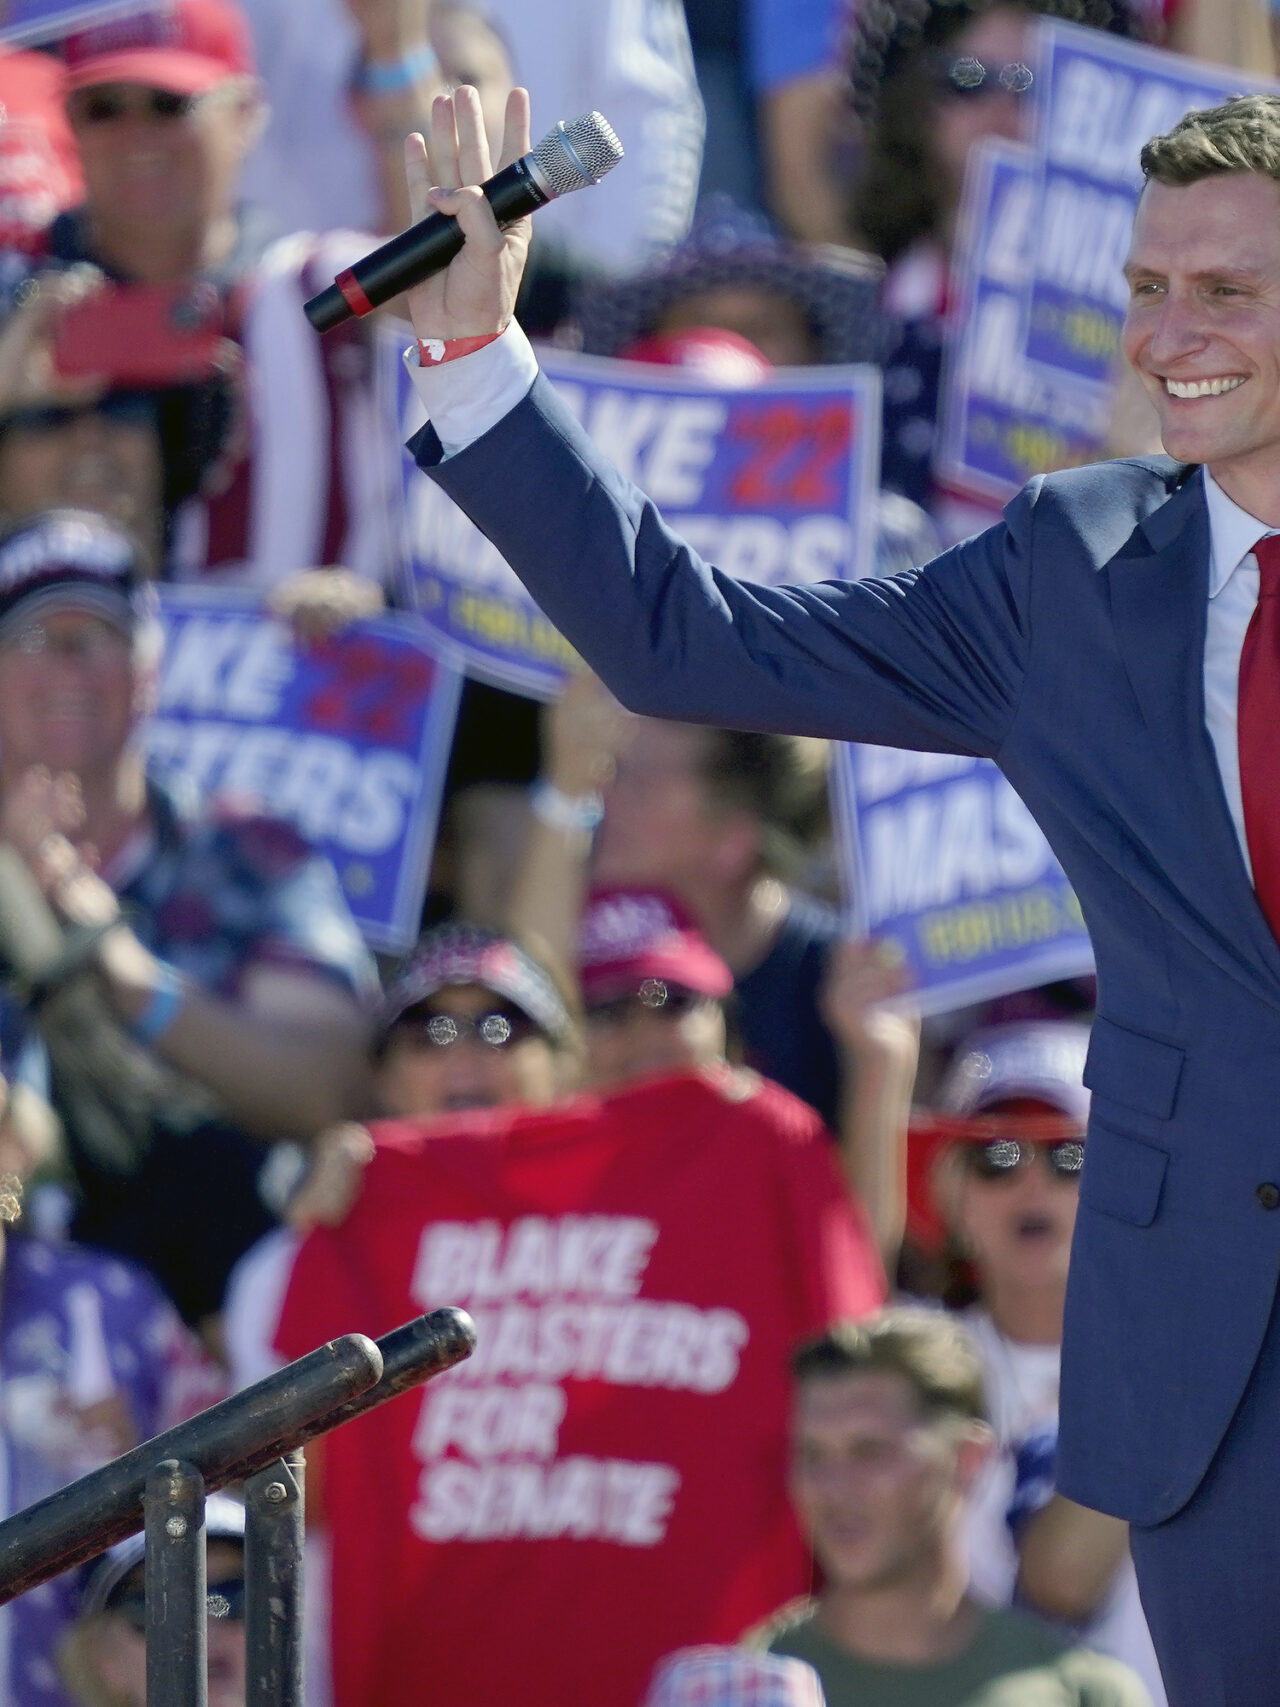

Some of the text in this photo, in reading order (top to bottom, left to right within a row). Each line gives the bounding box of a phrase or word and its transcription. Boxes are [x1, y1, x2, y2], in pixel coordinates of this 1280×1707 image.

[728, 402, 857, 512] 22
[412, 1214, 660, 1308] BLAKE
[412, 1382, 568, 1466] FOR
[410, 1454, 682, 1545] SENATE
